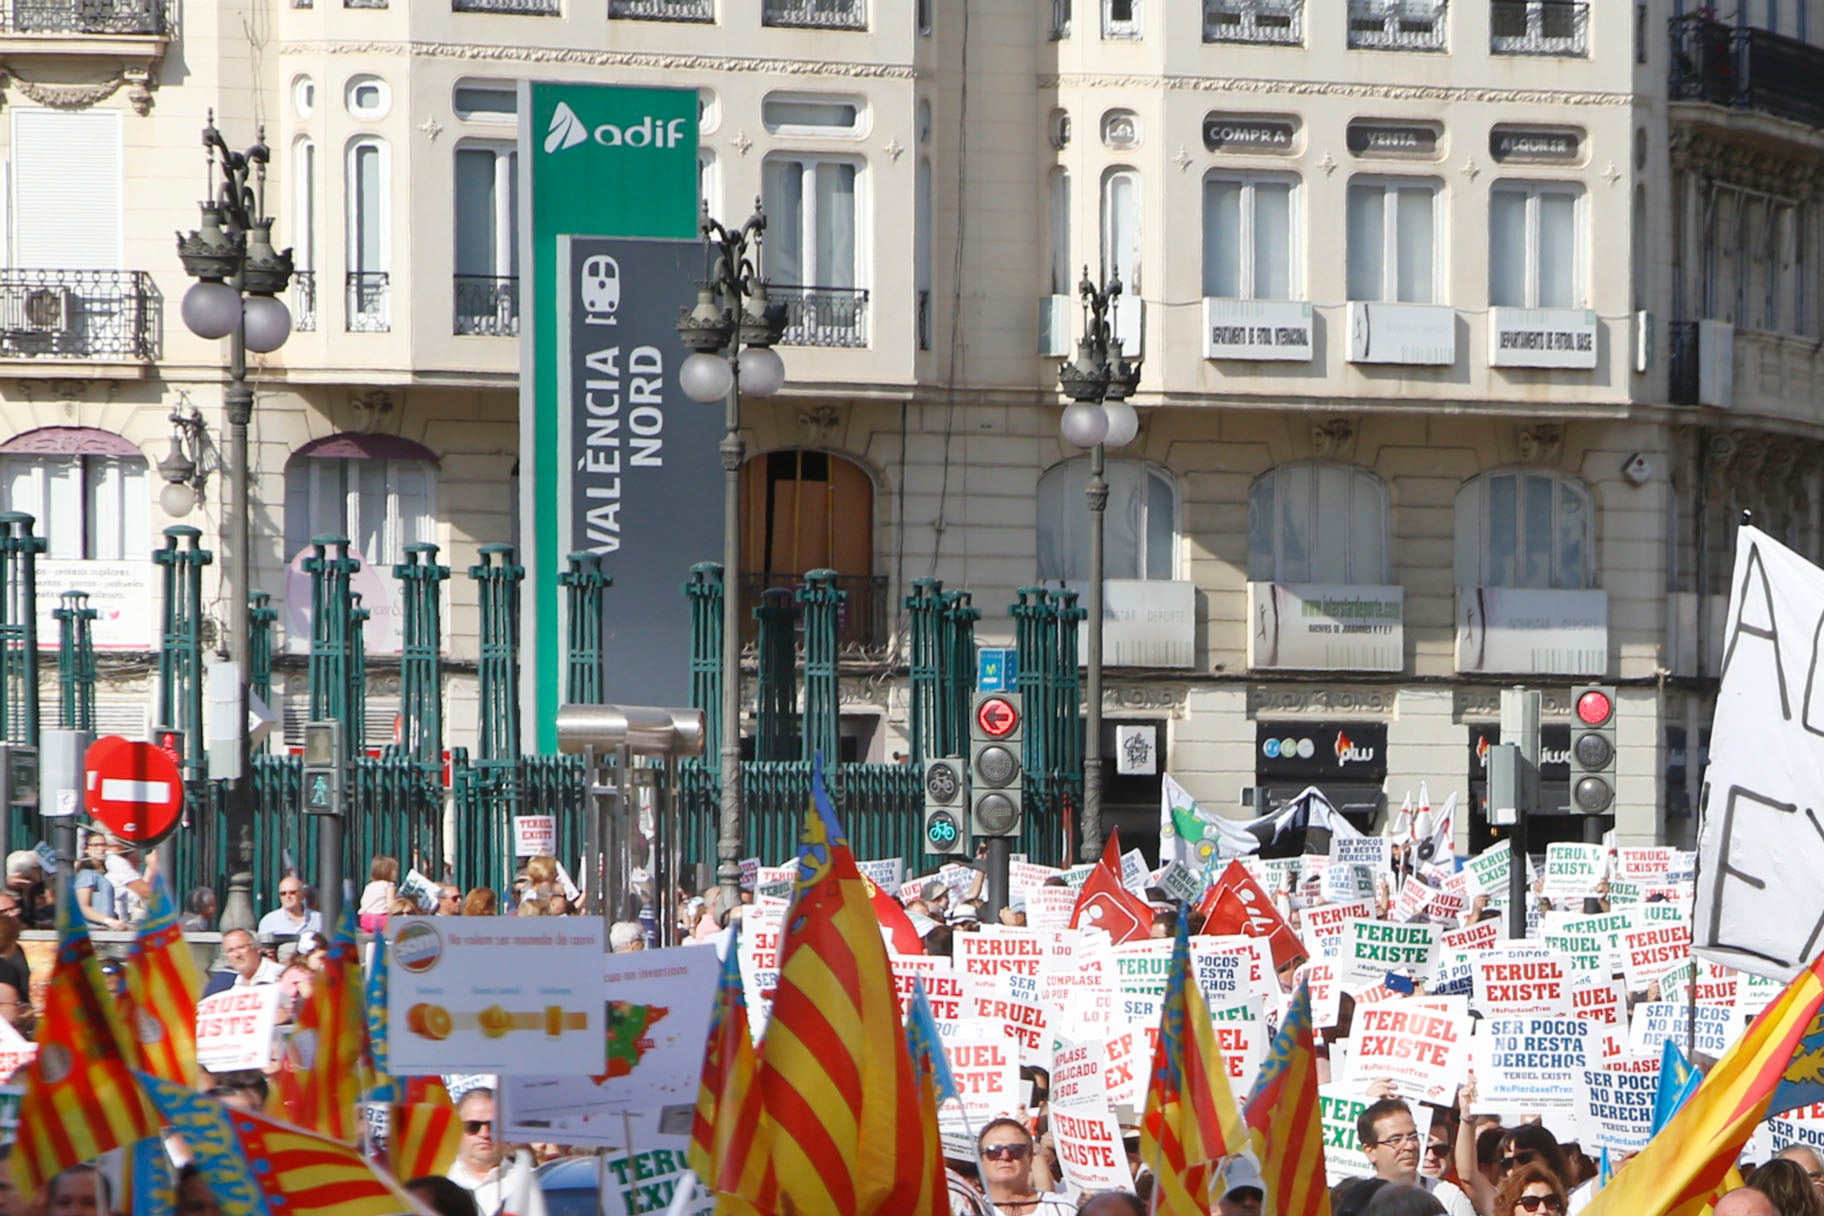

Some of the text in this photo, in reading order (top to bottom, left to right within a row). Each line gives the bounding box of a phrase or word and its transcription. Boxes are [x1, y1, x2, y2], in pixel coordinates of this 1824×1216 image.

[594, 116, 687, 148] adif
[1210, 127, 1286, 144] COMPRA
[1367, 132, 1418, 147] VENTA
[1500, 138, 1568, 153] ALQUILER
[629, 345, 663, 466] NORD
[578, 345, 621, 556] VALÈNCIA
[519, 820, 554, 831] TERUEL
[1336, 838, 1384, 847] SER POCOS
[1353, 846, 1383, 855] RESTA
[1337, 853, 1384, 863] DERECHOS
[1624, 850, 1671, 862] TERUEL
[1625, 861, 1671, 874] EXISTE
[1308, 904, 1371, 928] TERUEL
[1354, 922, 1433, 946] TERUEL
[1625, 925, 1691, 950] TERUEL
[963, 938, 1043, 956] TERUEL
[1354, 941, 1429, 964] EXISTE
[1632, 944, 1691, 967] EXISTE
[1481, 961, 1563, 982] TERUEL
[1486, 983, 1561, 1002] EXISTE
[1124, 1001, 1153, 1015] SER
[1647, 1005, 1673, 1017] SER
[1363, 1010, 1458, 1042] TERUEL
[1491, 1020, 1588, 1037] SER POCOS
[1360, 1035, 1450, 1067] EXISTE
[1494, 1037, 1584, 1052] NO RESTA
[1491, 1053, 1586, 1069] DERECHOS
[1504, 1072, 1535, 1081] TERUEL
[1584, 1071, 1659, 1091] SER POCO
[1590, 1087, 1657, 1107] NO REST
[1055, 1113, 1113, 1141] TERUEL
[1768, 1119, 1795, 1137] SER
[1060, 1141, 1115, 1168] EXISTE
